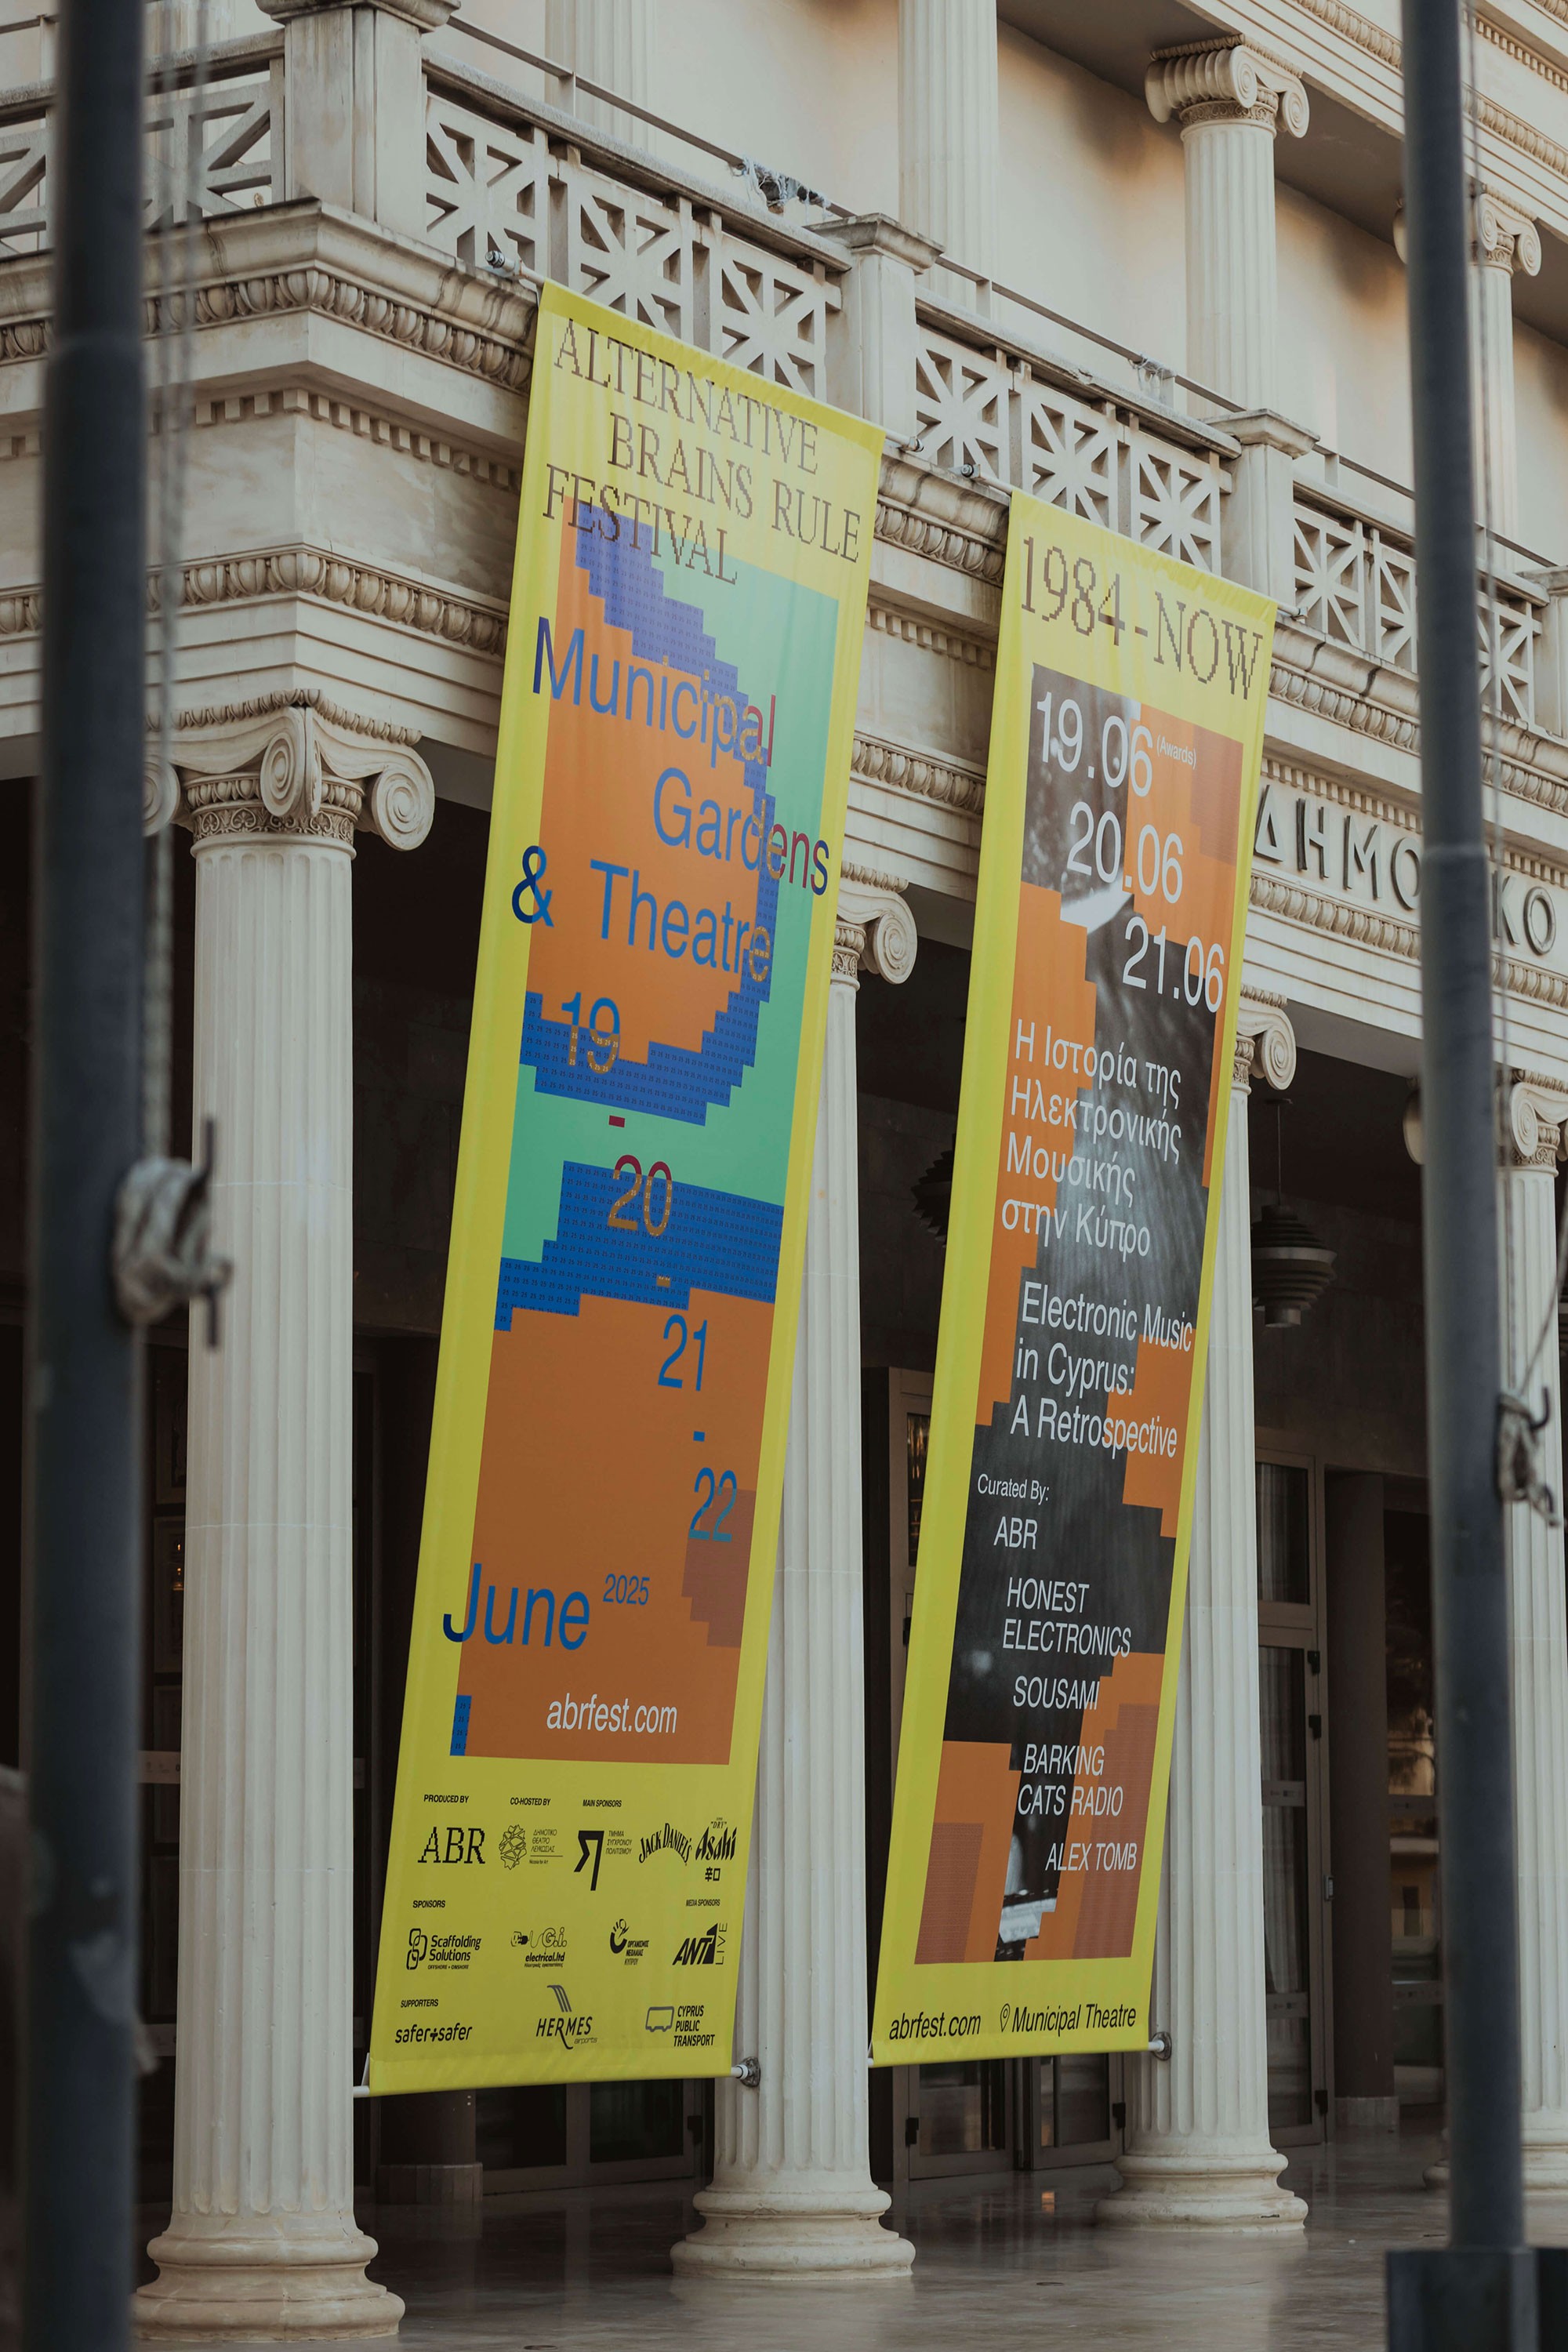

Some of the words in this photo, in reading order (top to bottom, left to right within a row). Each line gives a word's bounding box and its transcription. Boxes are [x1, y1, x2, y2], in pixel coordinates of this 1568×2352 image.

[554, 318, 818, 474] ALTERNATIVE
[608, 412, 753, 519] BRAINS
[771, 479, 860, 563] RULE
[543, 463, 738, 585] FESTIVAL
[1022, 536, 1263, 700] 1984-NOW
[532, 616, 776, 768] Municipal
[1036, 691, 1153, 797] 19.06
[1156, 735, 1197, 770] (Awards)
[653, 768, 829, 895] Gardens
[1067, 801, 1183, 903] 20.06
[1254, 785, 1556, 955] ΔΗΜΟΚΟ
[512, 845, 554, 927] &
[590, 858, 771, 982] Theatre
[1123, 916, 1225, 1013] 21.06
[561, 992, 620, 1074] 19
[1045, 1025, 1137, 1090] Ιστορία
[1145, 1062, 1181, 1109] της
[1011, 1075, 1181, 1164] Ηλεκτρονικής
[1007, 1131, 1135, 1207] Μουσικής
[608, 1154, 672, 1236] 20
[1002, 1199, 1068, 1247] στην
[1076, 1203, 1150, 1262] Κύπρο
[1022, 1281, 1137, 1341] Electronic
[1143, 1304, 1192, 1352] Music
[658, 1314, 707, 1391] 21
[1016, 1338, 1039, 1380] in
[1048, 1342, 1134, 1399] Cyprus:
[1010, 1395, 1029, 1436] A
[1037, 1397, 1178, 1460] Retrospective
[688, 1467, 737, 1542] 22
[978, 1474, 1027, 1498] Curated
[1030, 1480, 1050, 1505] By:
[993, 1516, 1038, 1549] ABR
[443, 1563, 590, 1650] June
[603, 1573, 650, 1606] 2025
[1007, 1577, 1090, 1613] HONEST
[1003, 1618, 1131, 1657] ELECTRONICS
[546, 1693, 677, 1733] abrfest.com
[1013, 1675, 1100, 1710] SOUSAMI
[1023, 1744, 1105, 1776] BARKING
[423, 1795, 459, 1803] PRODUCED
[459, 1795, 469, 1803] BY
[510, 1797, 543, 1806] CO-HOSTED
[1018, 1784, 1066, 1816] CATS
[1070, 1786, 1123, 1817] RADIO
[417, 1827, 485, 1864] ABR
[639, 1830, 662, 1864] JACK
[695, 1827, 737, 1861] Asahi
[1045, 1843, 1093, 1871] ALEX
[1095, 1842, 1138, 1871] TOMB
[429, 1948, 471, 1962] Solutions
[430, 1934, 481, 1951] Scaffolding
[401, 1998, 439, 2008] SUPPORTERS
[675, 2020, 700, 2032] PUBLIC
[677, 2005, 705, 2017] CYPRUS
[889, 2012, 982, 2040] abrfest.com
[1011, 2005, 1081, 2037] Municipal
[1086, 2003, 1136, 2029] Theatre
[535, 2016, 593, 2049] HERMES
[673, 2034, 715, 2047] TRANSPORT
